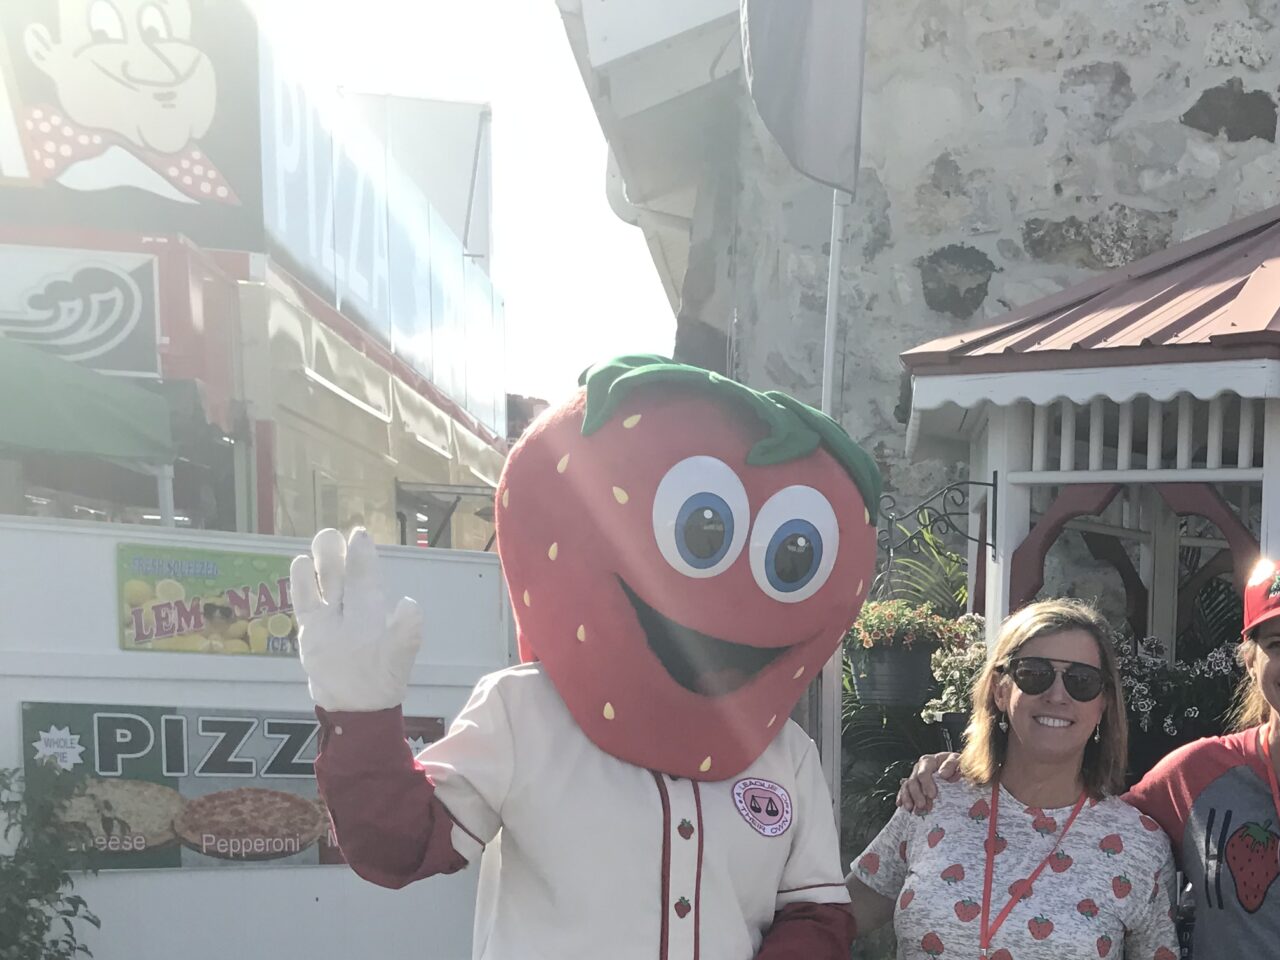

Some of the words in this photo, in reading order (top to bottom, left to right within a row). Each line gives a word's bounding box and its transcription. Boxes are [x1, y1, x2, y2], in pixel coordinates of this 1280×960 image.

[132, 557, 165, 575] FRESH
[168, 559, 219, 578] SQUEEZED
[267, 636, 289, 653] ICE
[43, 737, 76, 749] WHOLE
[93, 712, 321, 778] PIZZ
[202, 833, 300, 858] Pepperoni
